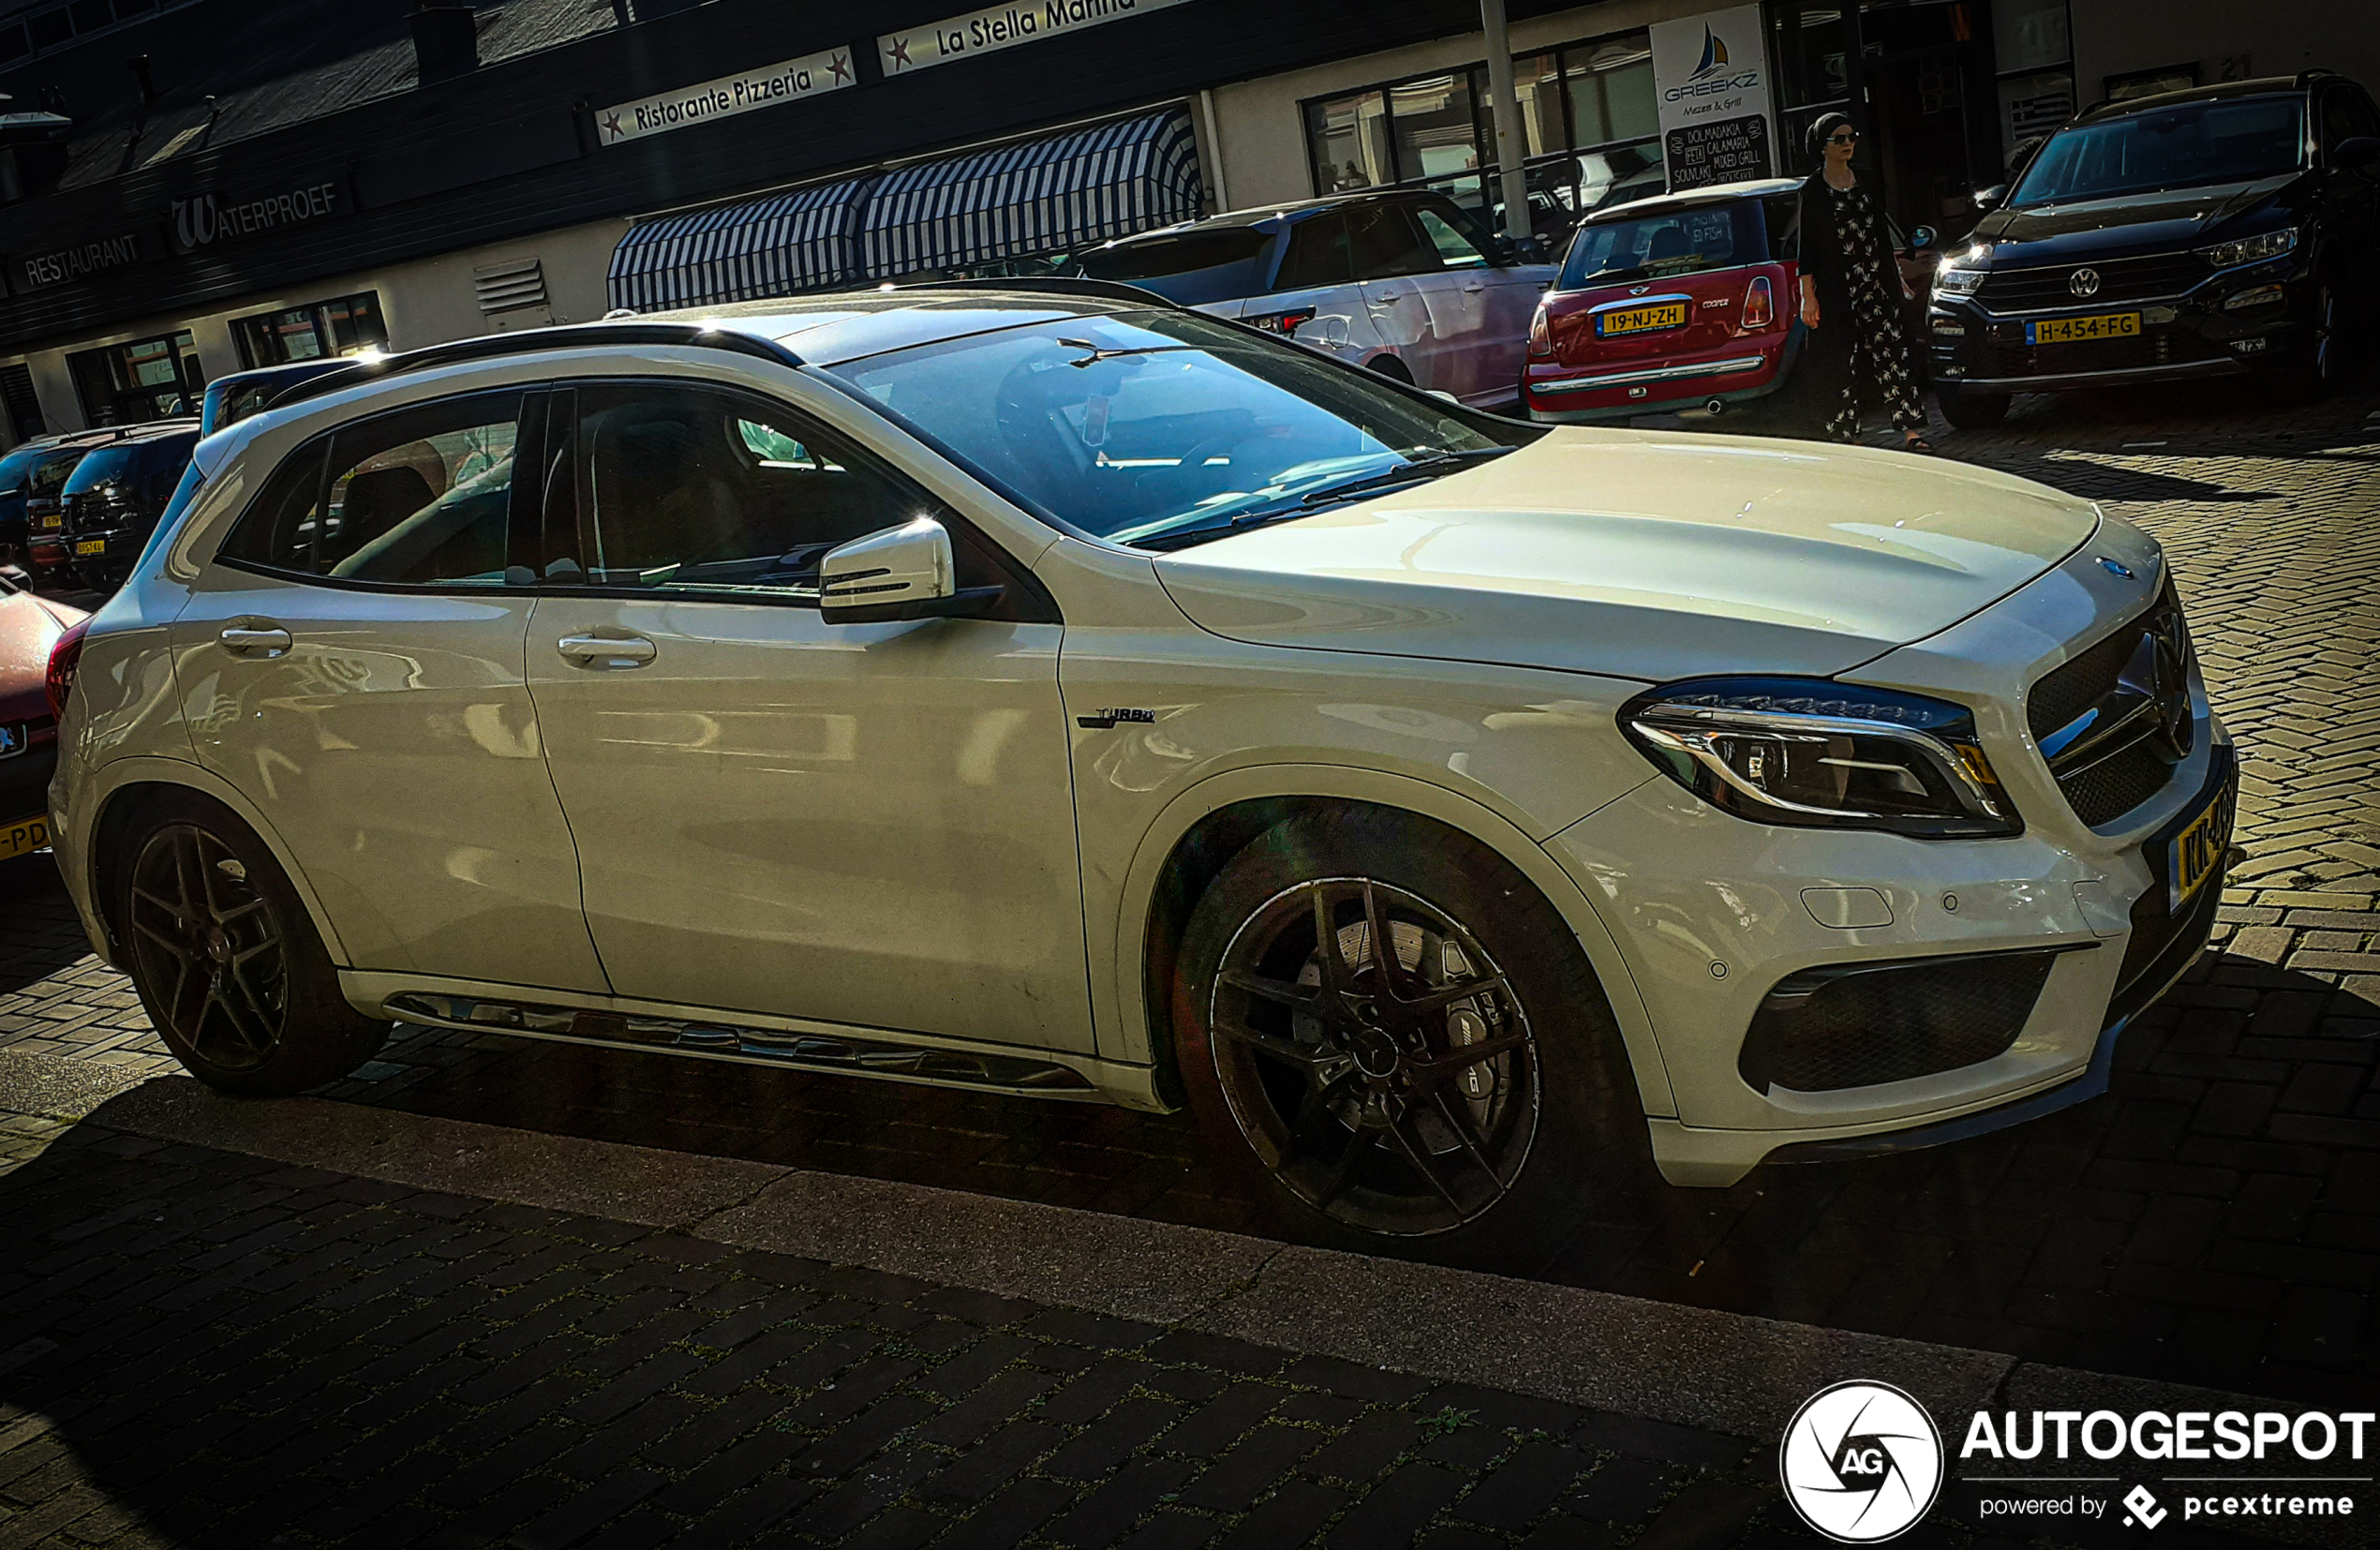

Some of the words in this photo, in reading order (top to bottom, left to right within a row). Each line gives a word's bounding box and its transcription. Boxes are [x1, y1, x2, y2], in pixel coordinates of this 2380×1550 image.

[936, 29, 965, 55] La
[970, 9, 1037, 47] Stella
[1664, 73, 1758, 102] GREEKZ
[635, 88, 730, 131] Ristorante
[733, 67, 811, 106] Pizzeria
[1724, 97, 1741, 109] Grill
[1688, 123, 1741, 144] DOLMADAKIA
[1687, 149, 1703, 164] FETA
[1713, 154, 1737, 170] MIXED
[1738, 150, 1761, 165] GRILL
[1674, 165, 1712, 184] SOUVLAKI
[25, 234, 141, 286] RESTAURANT
[171, 183, 336, 248] WATERPROEF
[1704, 226, 1722, 241] FISH
[1703, 298, 1729, 309] COOPER
[1611, 307, 1677, 330] 19-NJ-ZH
[2041, 316, 2134, 341] H-454-FG
[1095, 708, 1155, 721] TURBO
